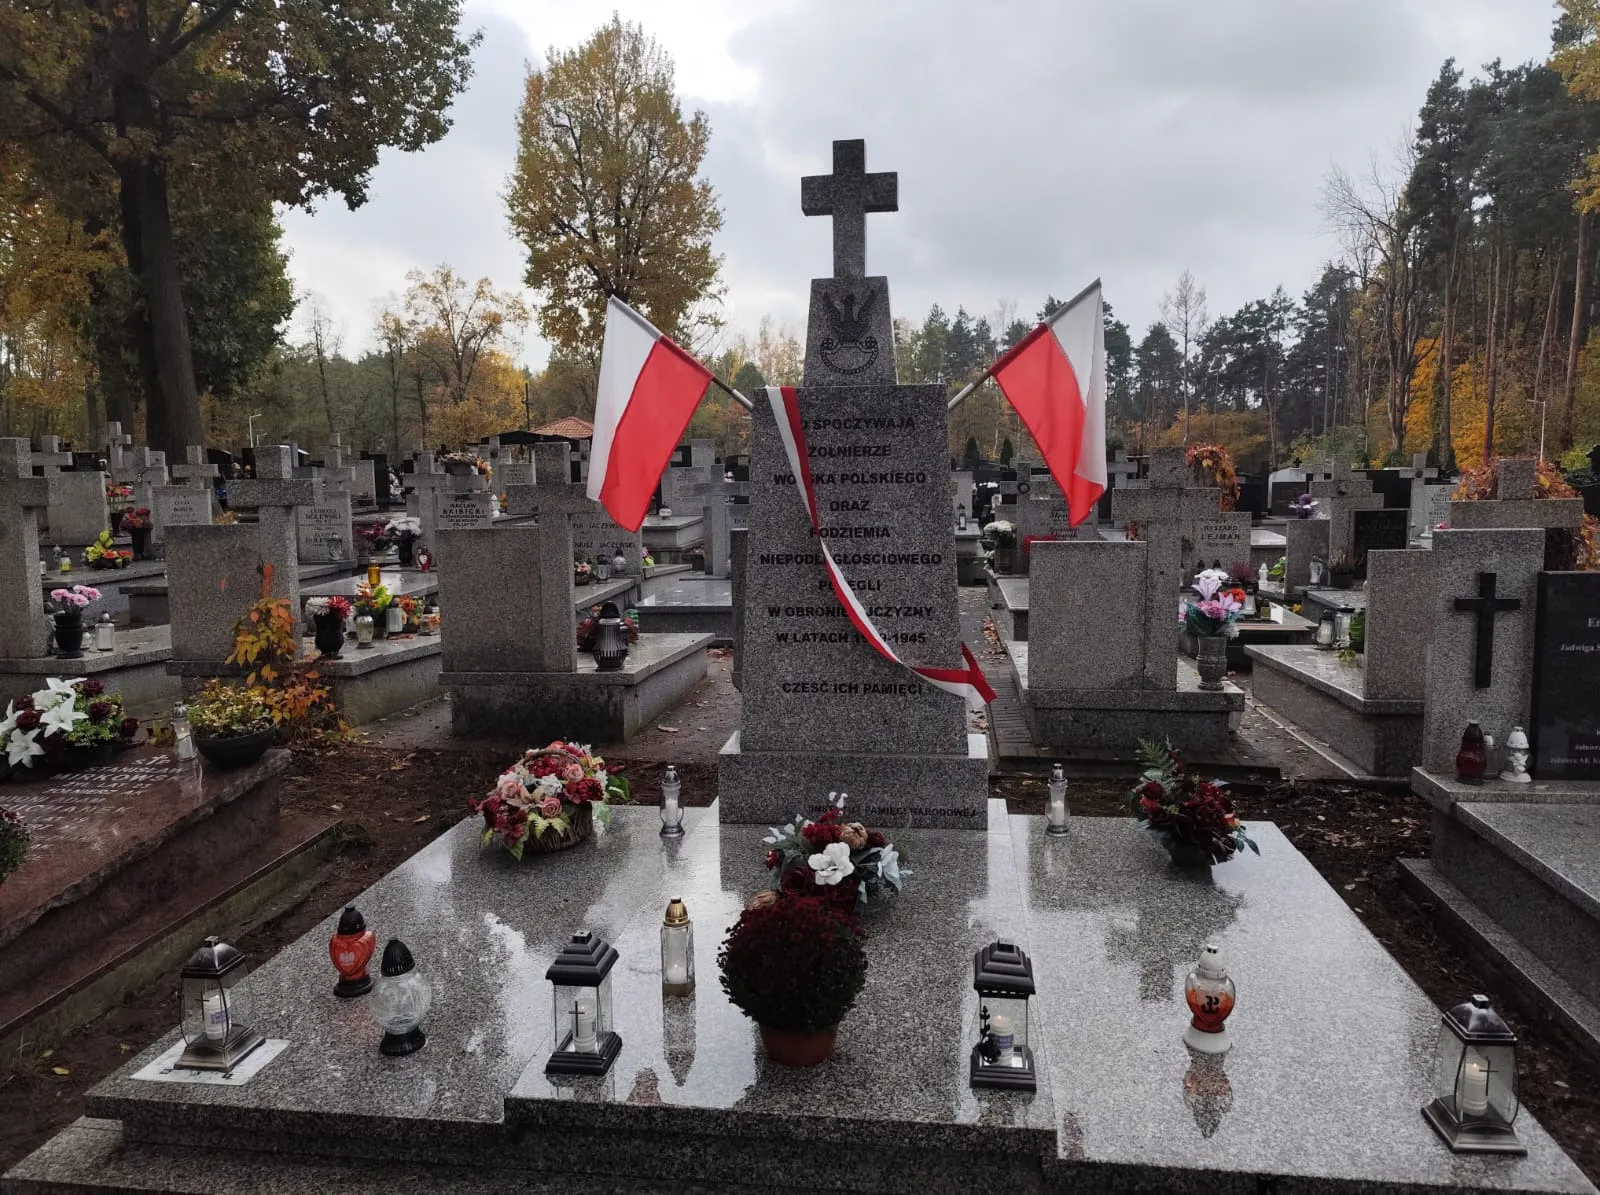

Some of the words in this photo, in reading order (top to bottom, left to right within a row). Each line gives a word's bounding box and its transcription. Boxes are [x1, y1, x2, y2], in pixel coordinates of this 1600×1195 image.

[840, 471, 927, 484] POLSKIEGO
[829, 500, 870, 512] ORAZ
[768, 606, 780, 617] W
[785, 606, 850, 617] OBRONIE
[866, 606, 933, 617] JCZYZNY
[776, 632, 789, 642] W
[793, 632, 849, 643] LATACH
[833, 682, 859, 694] ICH
